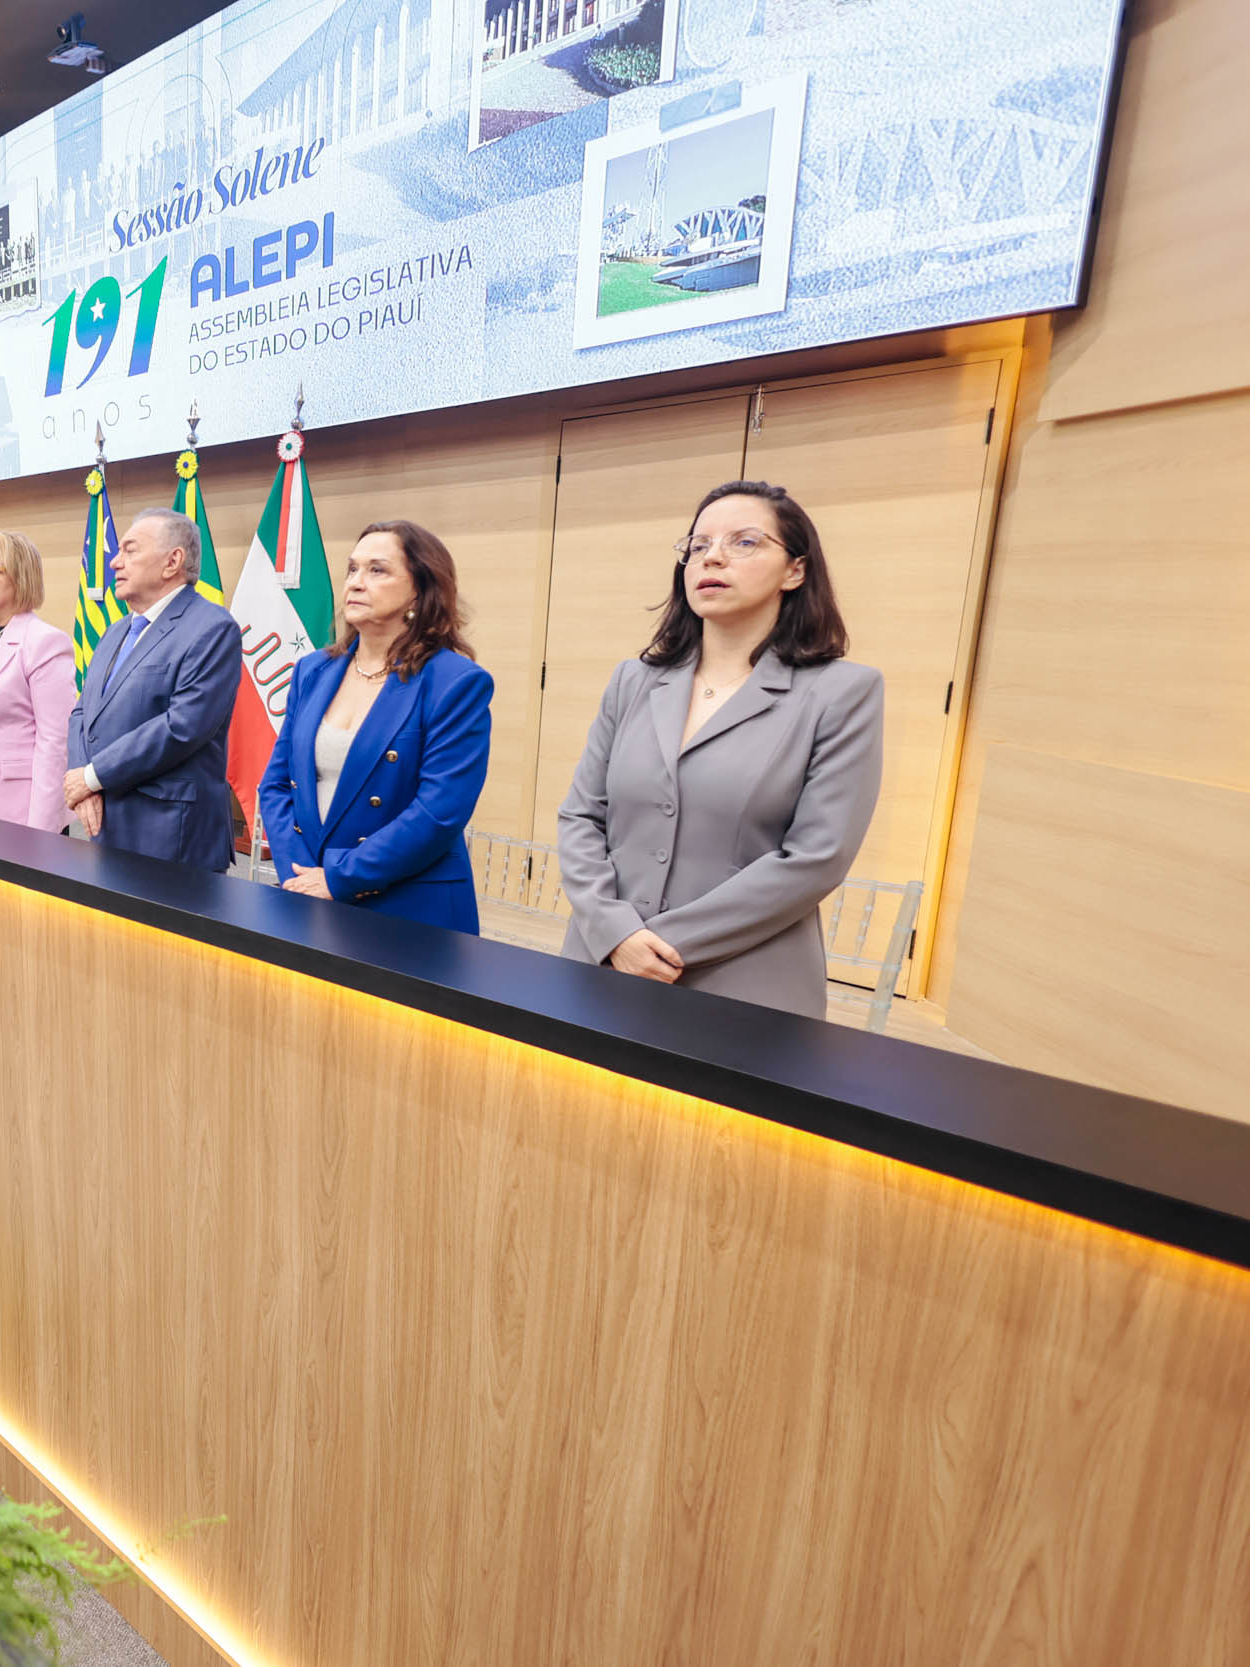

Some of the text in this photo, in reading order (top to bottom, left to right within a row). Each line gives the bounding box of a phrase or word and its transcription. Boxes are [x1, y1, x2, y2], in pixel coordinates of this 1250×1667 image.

[109, 137, 325, 253] Sessão Solene
[189, 245, 472, 344] ASSEMBLEIA LEGISLATIVA
[190, 211, 335, 309] ALEPI
[42, 255, 168, 397] 191
[190, 292, 423, 375] DO ESTADO DO PIAUÍ
[42, 394, 152, 439] anos
